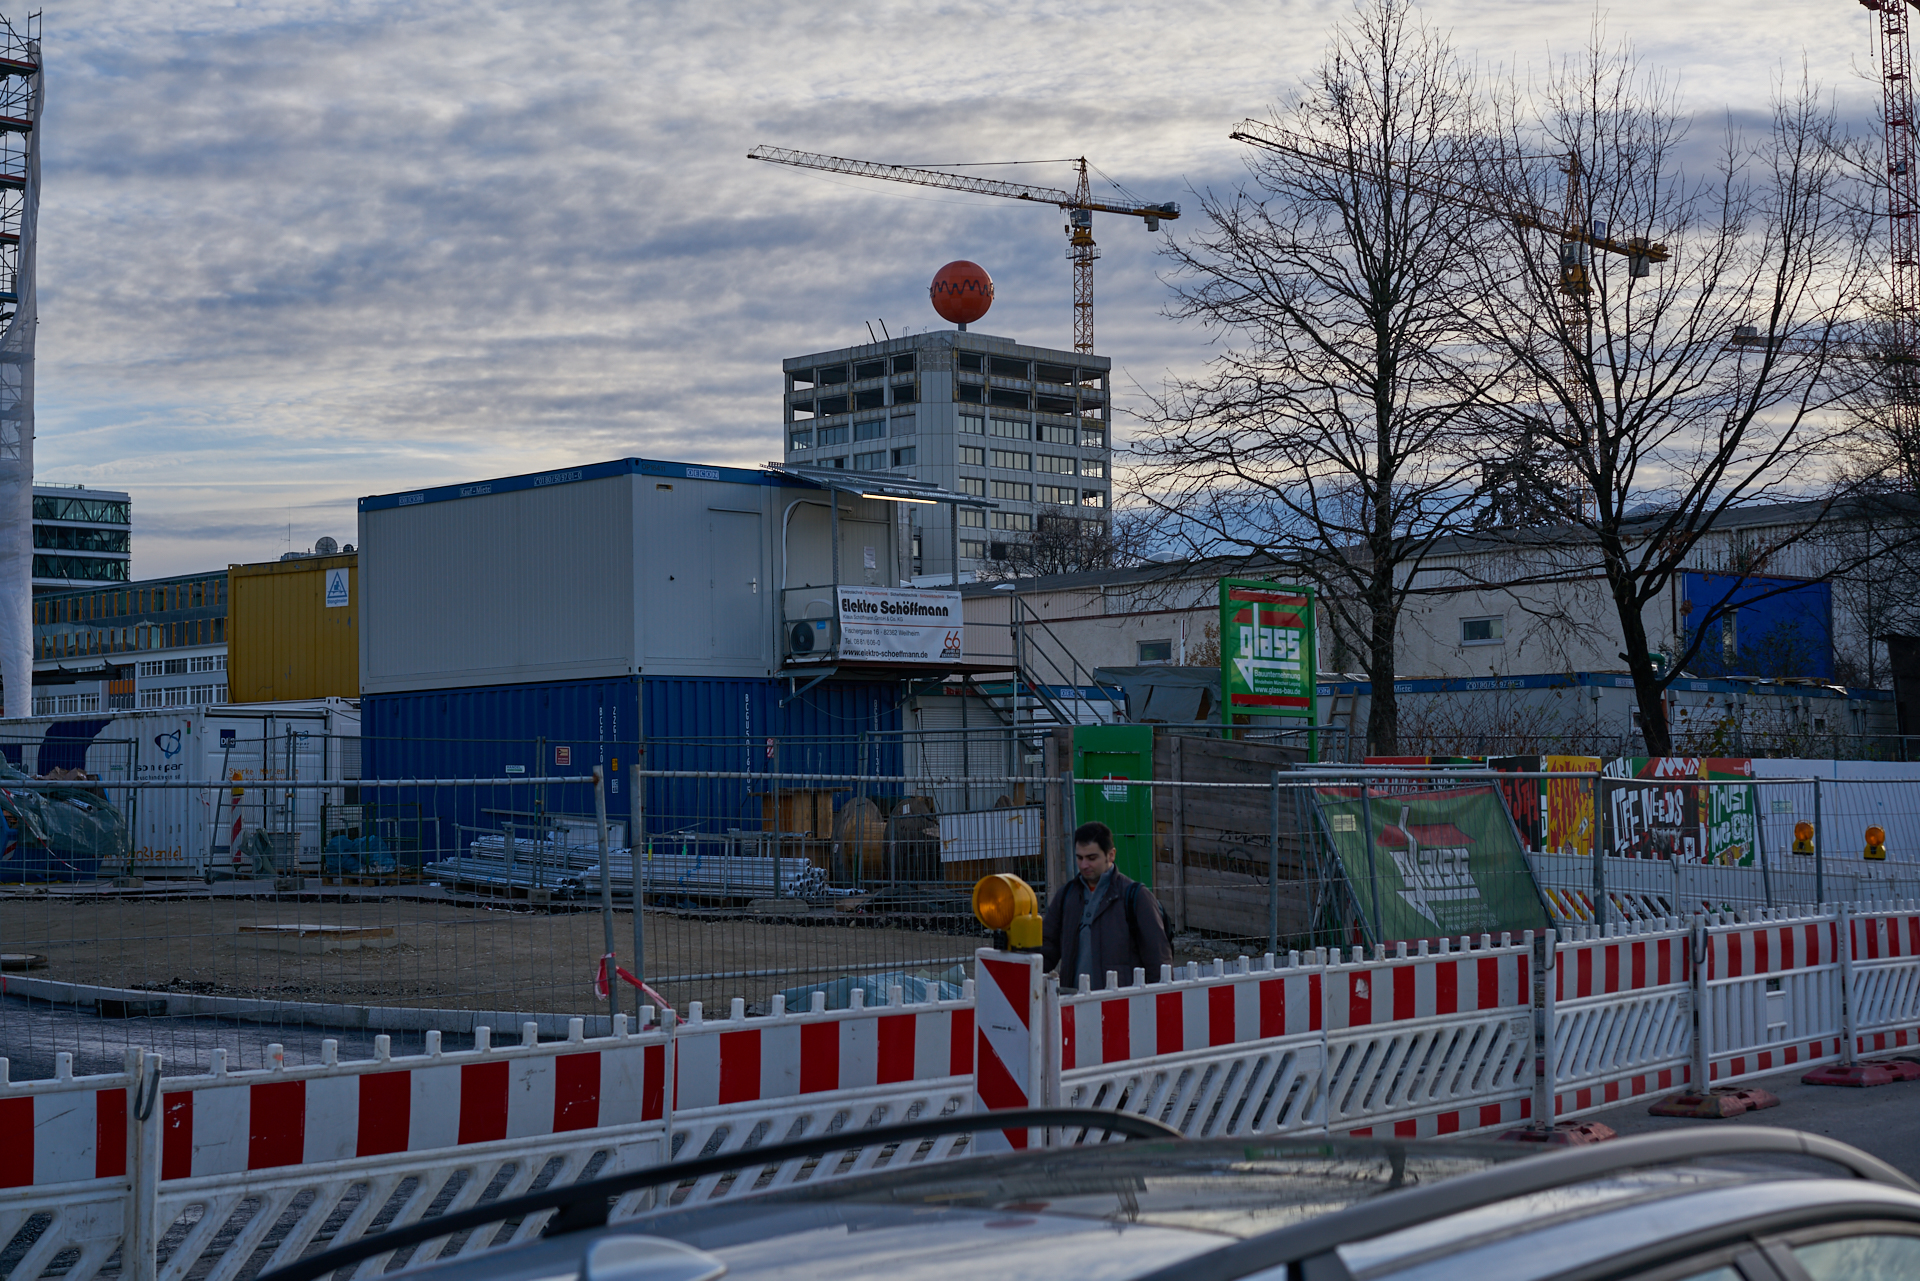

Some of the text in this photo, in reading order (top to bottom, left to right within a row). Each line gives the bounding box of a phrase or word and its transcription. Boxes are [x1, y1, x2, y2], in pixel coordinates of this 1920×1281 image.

[687, 468, 719, 480] OECON
[842, 598, 949, 616] Elektro Schöffmann
[944, 631, 960, 649] 66
[1240, 602, 1300, 660] glass
[1254, 670, 1300, 681] Bauunternehmung
[1255, 686, 1301, 695] www.glass-bau.de
[1641, 787, 1684, 832] NEEDS
